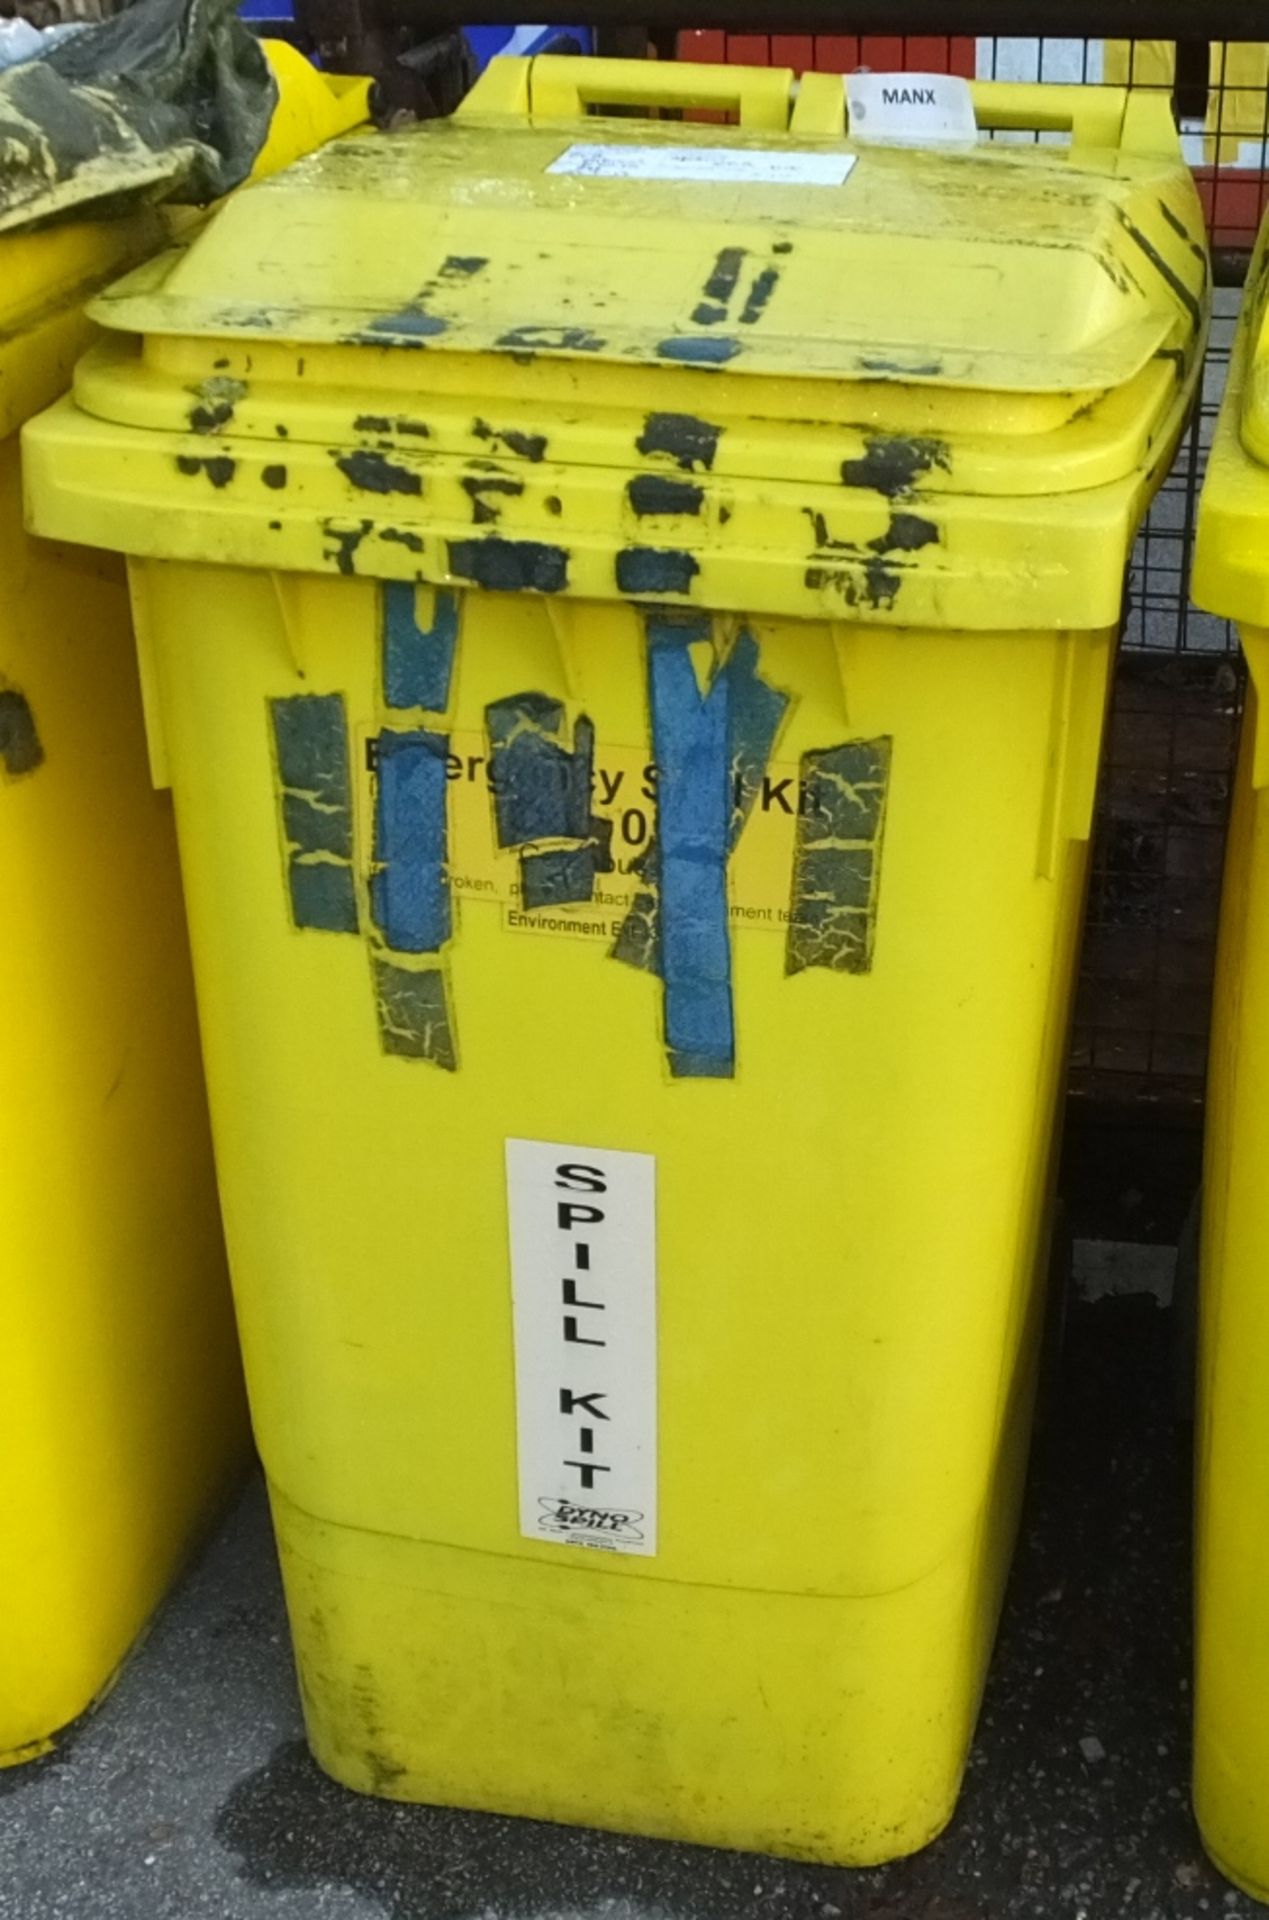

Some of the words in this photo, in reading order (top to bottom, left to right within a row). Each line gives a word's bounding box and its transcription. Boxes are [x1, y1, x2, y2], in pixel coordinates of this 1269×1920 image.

[882, 88, 936, 105] MANX
[508, 909, 607, 936] Environment
[554, 1163, 608, 1347] SPILL
[559, 1387, 612, 1489] KIT
[554, 1514, 623, 1532] SPILL
[556, 1505, 629, 1523] DYNO
